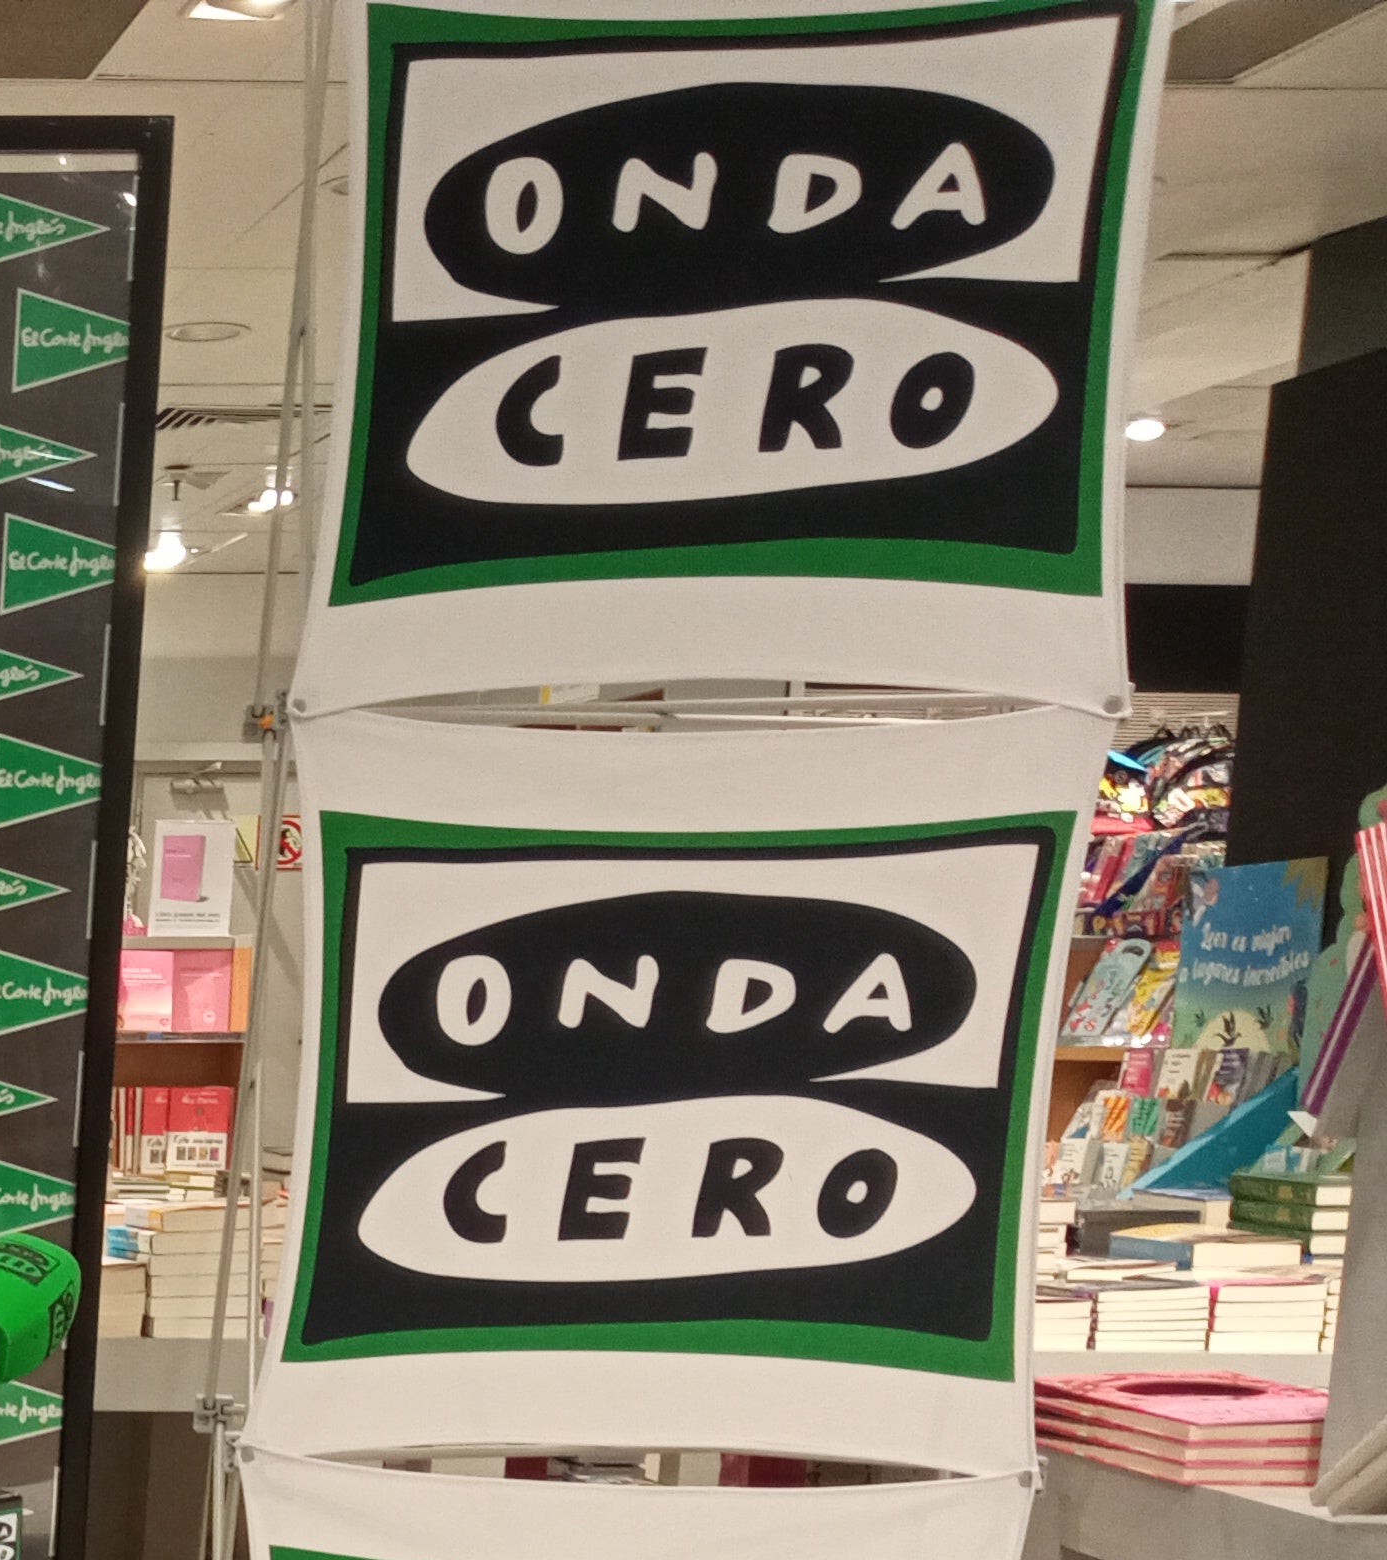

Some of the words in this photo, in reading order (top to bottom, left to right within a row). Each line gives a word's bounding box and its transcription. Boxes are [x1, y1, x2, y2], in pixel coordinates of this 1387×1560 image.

[484, 141, 987, 255] ONDA
[494, 343, 976, 467] CERO
[436, 953, 913, 1047] ONDA
[443, 1136, 898, 1243] CERO
